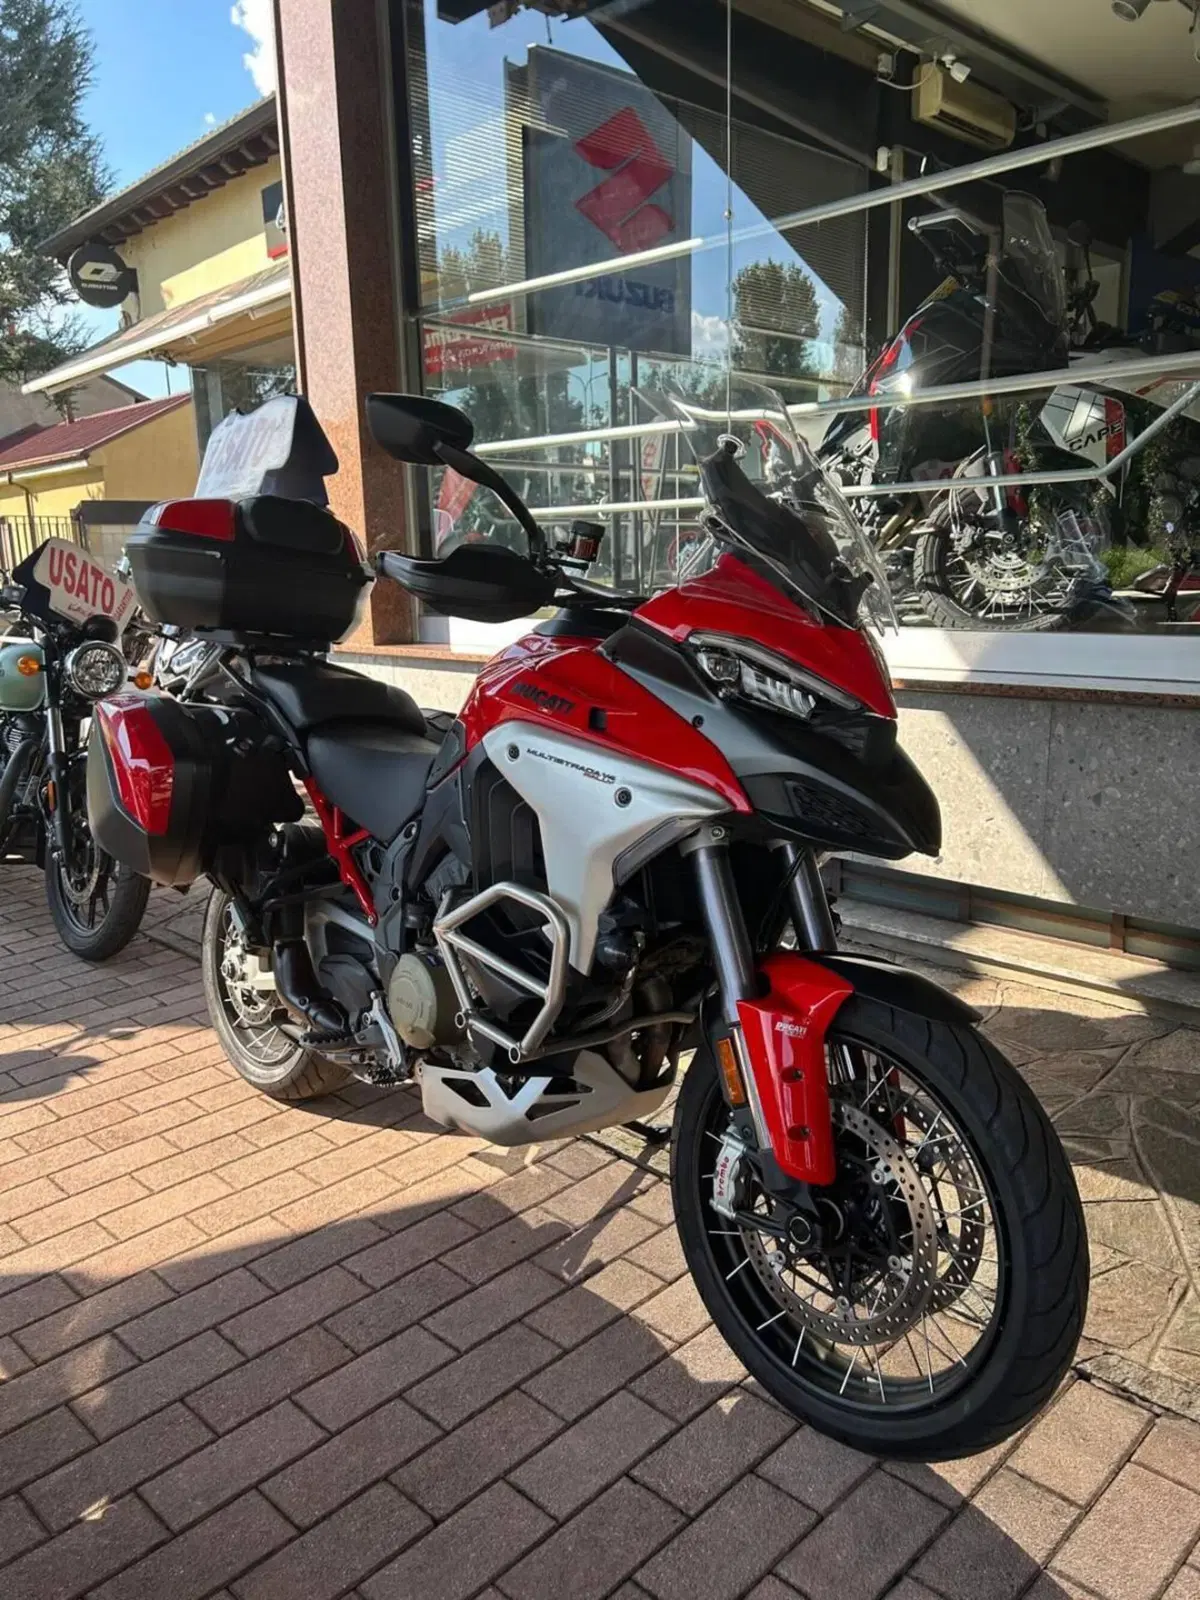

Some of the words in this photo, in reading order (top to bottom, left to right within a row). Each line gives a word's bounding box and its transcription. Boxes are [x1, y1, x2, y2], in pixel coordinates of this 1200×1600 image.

[1069, 420, 1123, 452] CAPE
[49, 546, 115, 614] USATO
[510, 683, 575, 714] DUCATI
[526, 748, 601, 777] MULTISTRADA
[775, 1021, 808, 1036] DUCATI
[716, 1156, 730, 1197] brembo
